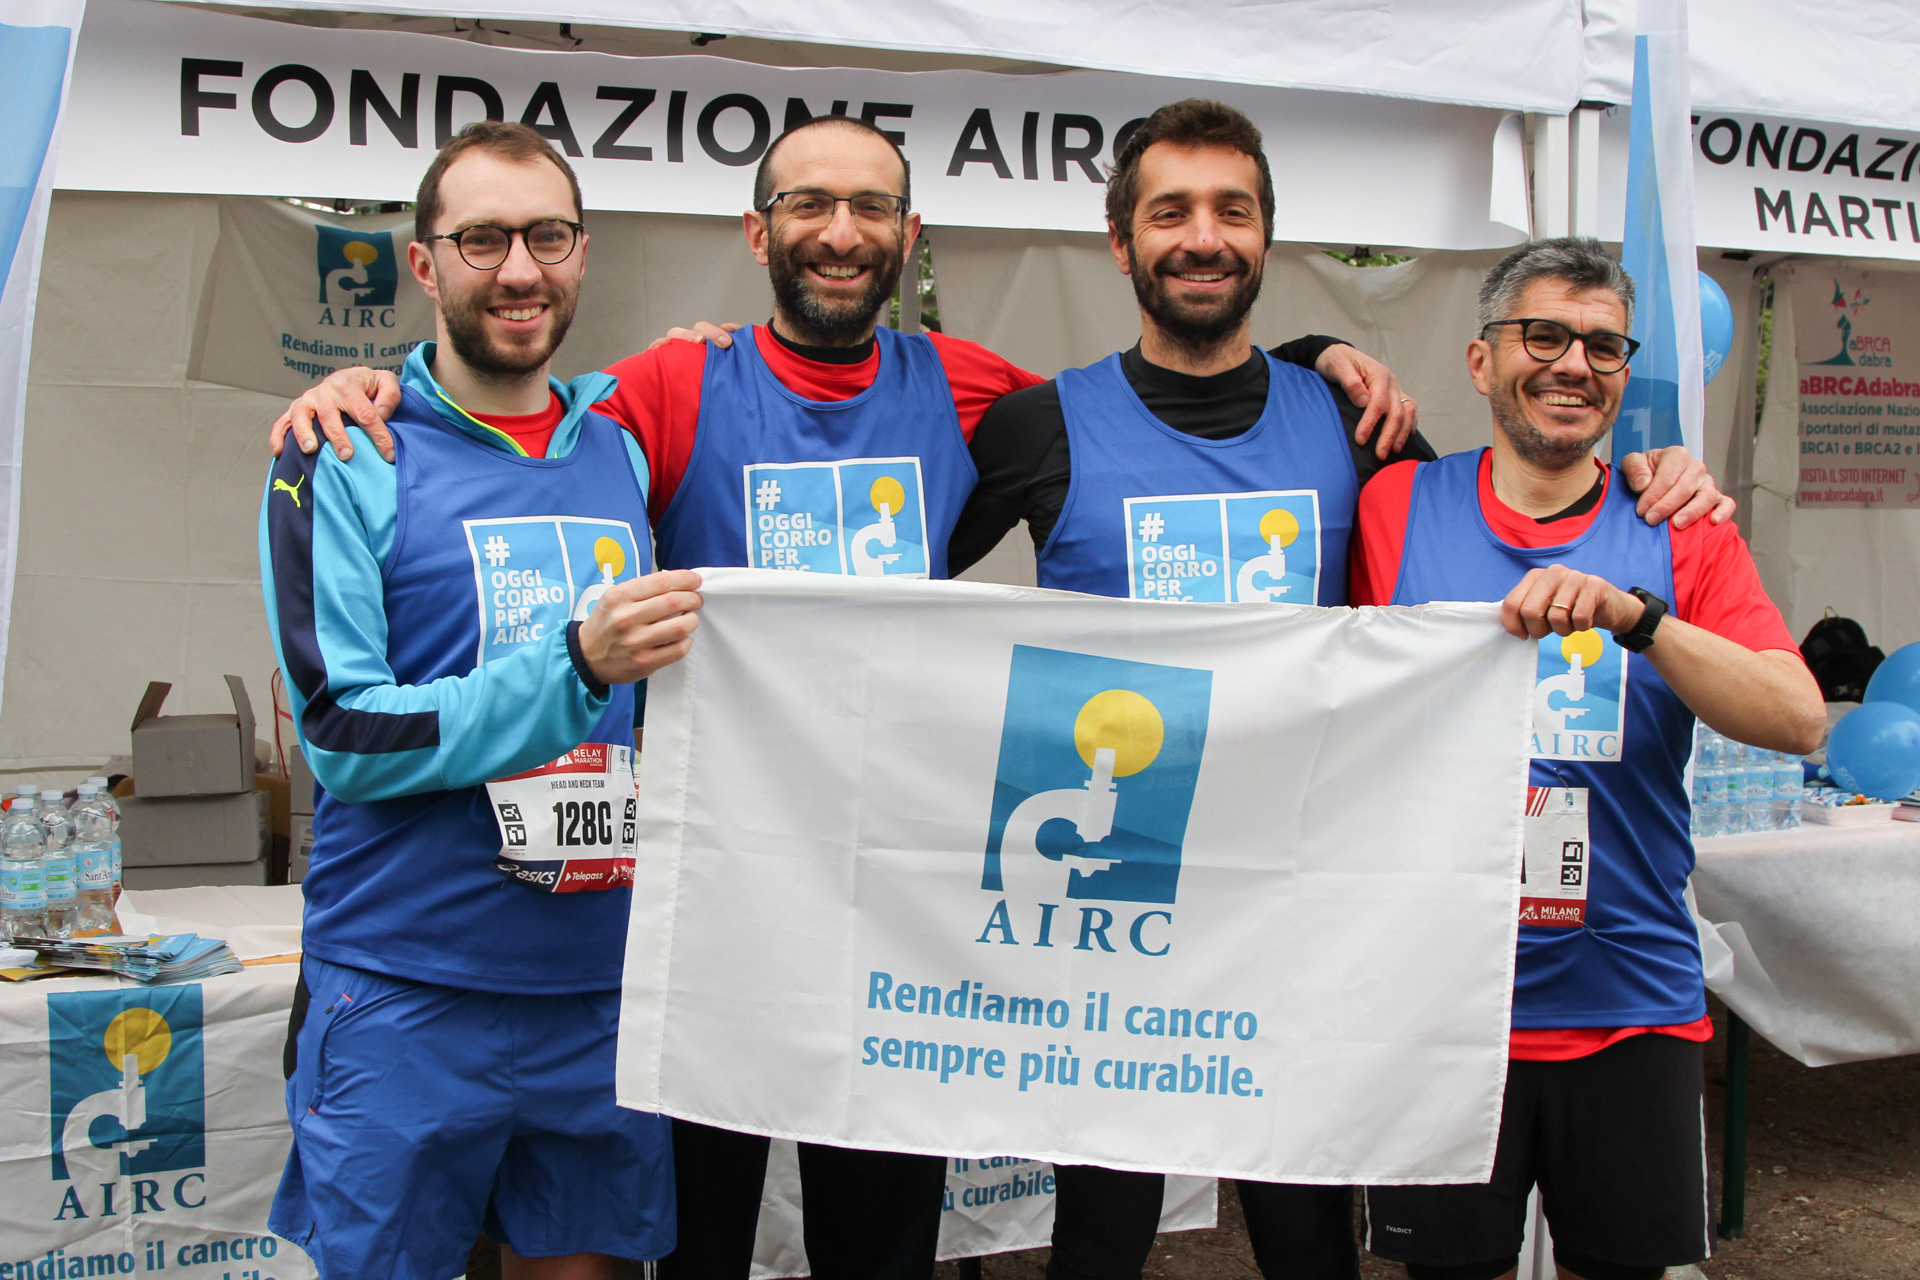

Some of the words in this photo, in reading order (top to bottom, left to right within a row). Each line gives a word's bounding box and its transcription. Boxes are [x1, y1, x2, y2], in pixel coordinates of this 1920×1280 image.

[318, 306, 396, 328] AIRC
[281, 332, 358, 358] Rendiamo
[364, 342, 374, 358] il
[1849, 336, 1891, 352] aBRCA
[1859, 352, 1892, 368] dabra
[1800, 376, 1920, 398] aBRCAdabra
[1801, 402, 1883, 416] Associazione
[1806, 421, 1862, 436] portatori
[1866, 422, 1879, 435] di
[1801, 441, 1839, 455] BRCA1
[1843, 444, 1851, 455] e
[1855, 442, 1901, 455] BRCA2
[1905, 445, 1913, 455] e
[1800, 468, 1828, 483] VISITA
[1830, 468, 1838, 484] IL
[1840, 468, 1860, 484] SITO
[1862, 468, 1906, 484] INTERNET
[1801, 487, 1884, 503] www.abrcadabra.it
[758, 512, 813, 532] OGGI
[760, 528, 832, 549] CORRO
[761, 548, 800, 567] PER
[1142, 543, 1196, 563] OGGI
[490, 569, 543, 590] OGGI
[1143, 559, 1218, 580] CORRO
[493, 585, 565, 609] CORRO
[1144, 579, 1183, 598] PER
[494, 607, 533, 628] PER
[492, 623, 545, 646] AIRC
[573, 748, 602, 758] RELAY
[1531, 732, 1618, 758] AIRC
[551, 780, 567, 790] HEAD
[568, 780, 579, 789] AND
[580, 780, 592, 789] NECK
[592, 779, 606, 789] TEAM
[552, 801, 613, 847] 128C
[571, 871, 604, 882] Telepass
[1541, 906, 1580, 916] MILANO
[975, 899, 1173, 957] AIRC
[867, 971, 1070, 1030] Rendiamo
[1084, 991, 1110, 1032] il
[1124, 1003, 1258, 1041] cancro
[862, 1034, 1006, 1084] sempre
[1018, 1044, 1081, 1092] più
[1094, 1053, 1264, 1098] curabile.
[53, 1172, 207, 1221] AIRC
[1386, 1224, 1413, 1235] EVADICT
[146, 1239, 165, 1272] il
[177, 1235, 278, 1267] cancro
